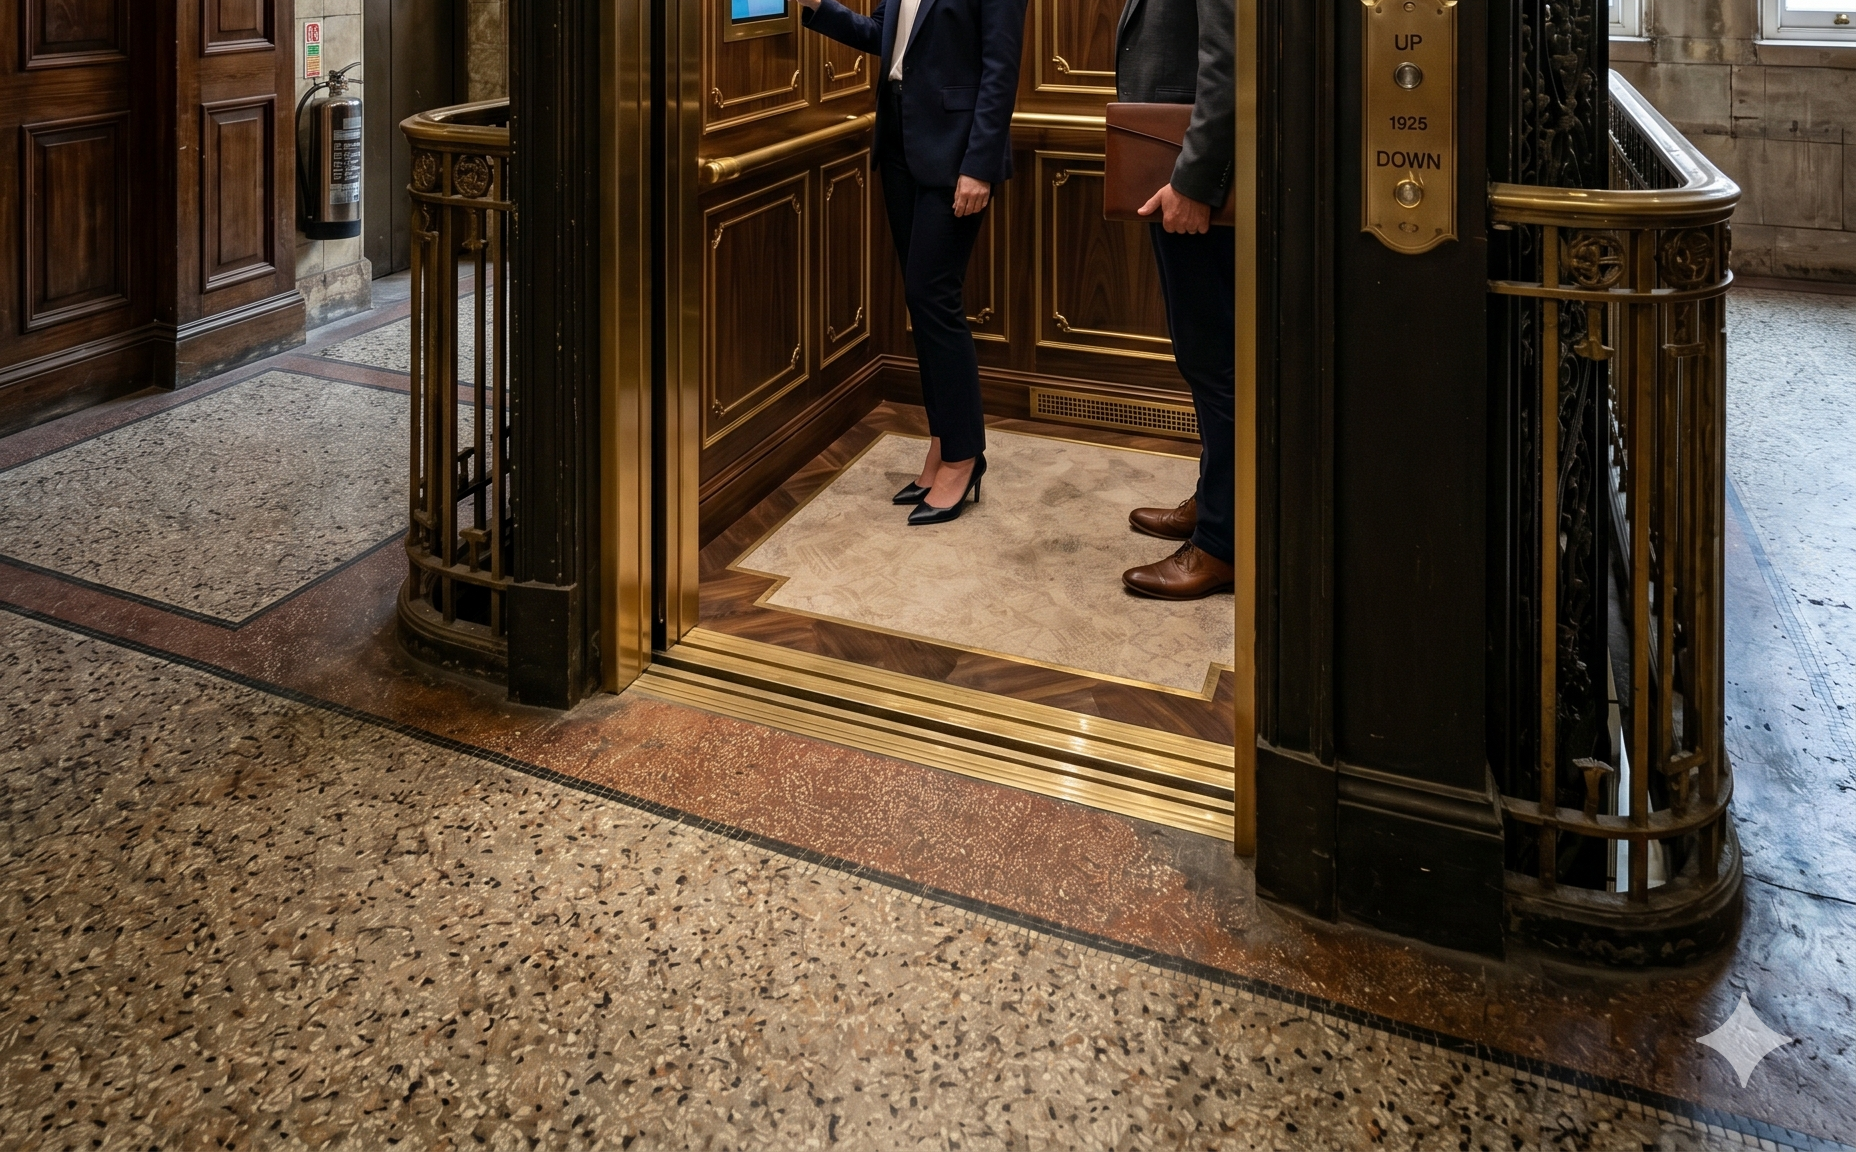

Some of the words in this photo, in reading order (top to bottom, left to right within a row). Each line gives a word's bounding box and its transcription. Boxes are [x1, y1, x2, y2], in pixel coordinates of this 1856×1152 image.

[1394, 33, 1423, 51] UP
[1388, 115, 1428, 131] 1925
[1376, 150, 1441, 170] DOWN
